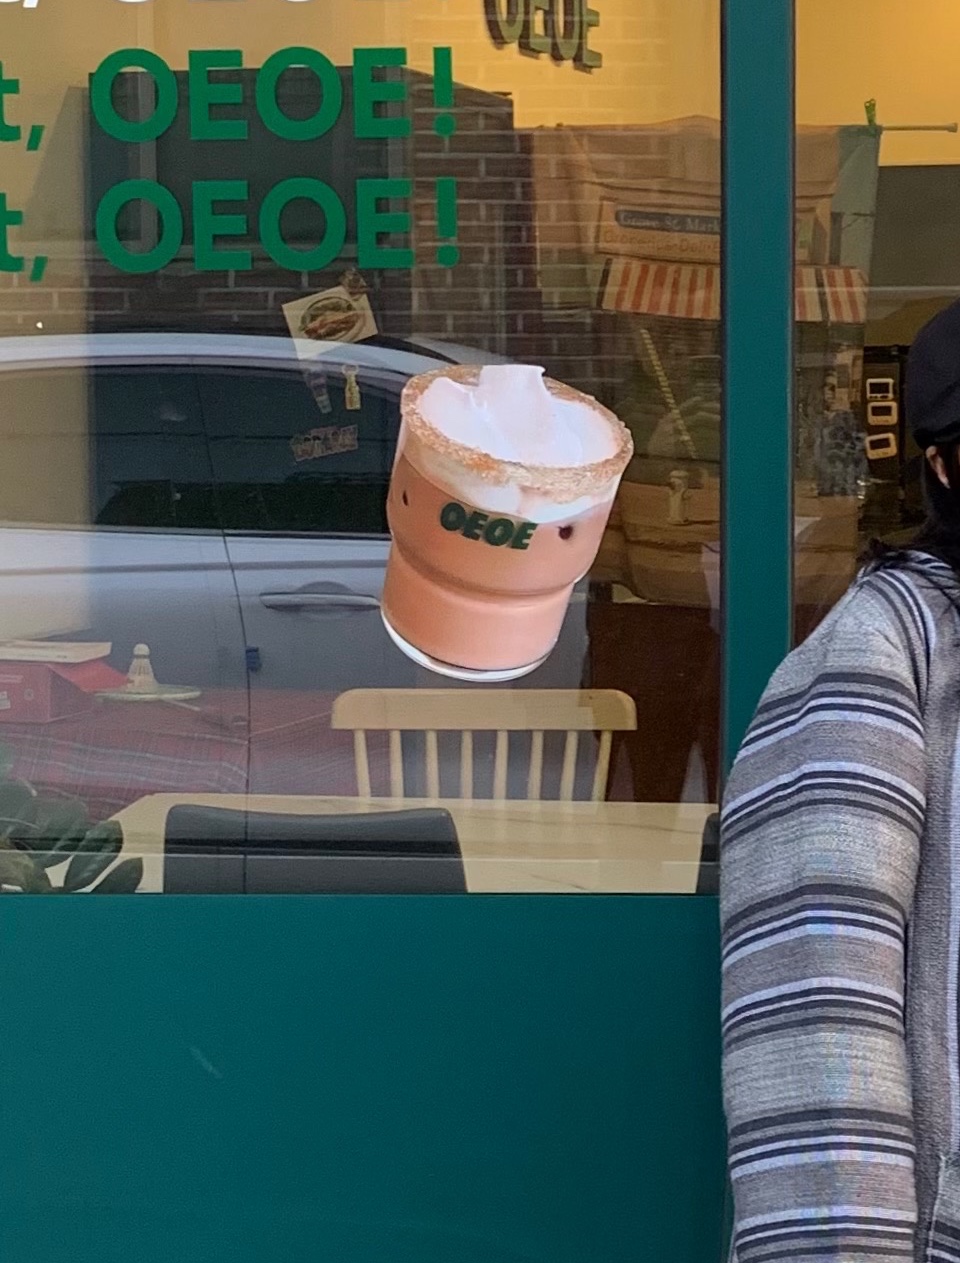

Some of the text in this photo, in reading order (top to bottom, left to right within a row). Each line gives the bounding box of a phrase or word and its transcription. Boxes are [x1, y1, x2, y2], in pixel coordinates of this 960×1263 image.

[91, 48, 454, 142] OEOE!
[97, 178, 459, 272] OEOE!
[440, 502, 538, 550] OEOE
